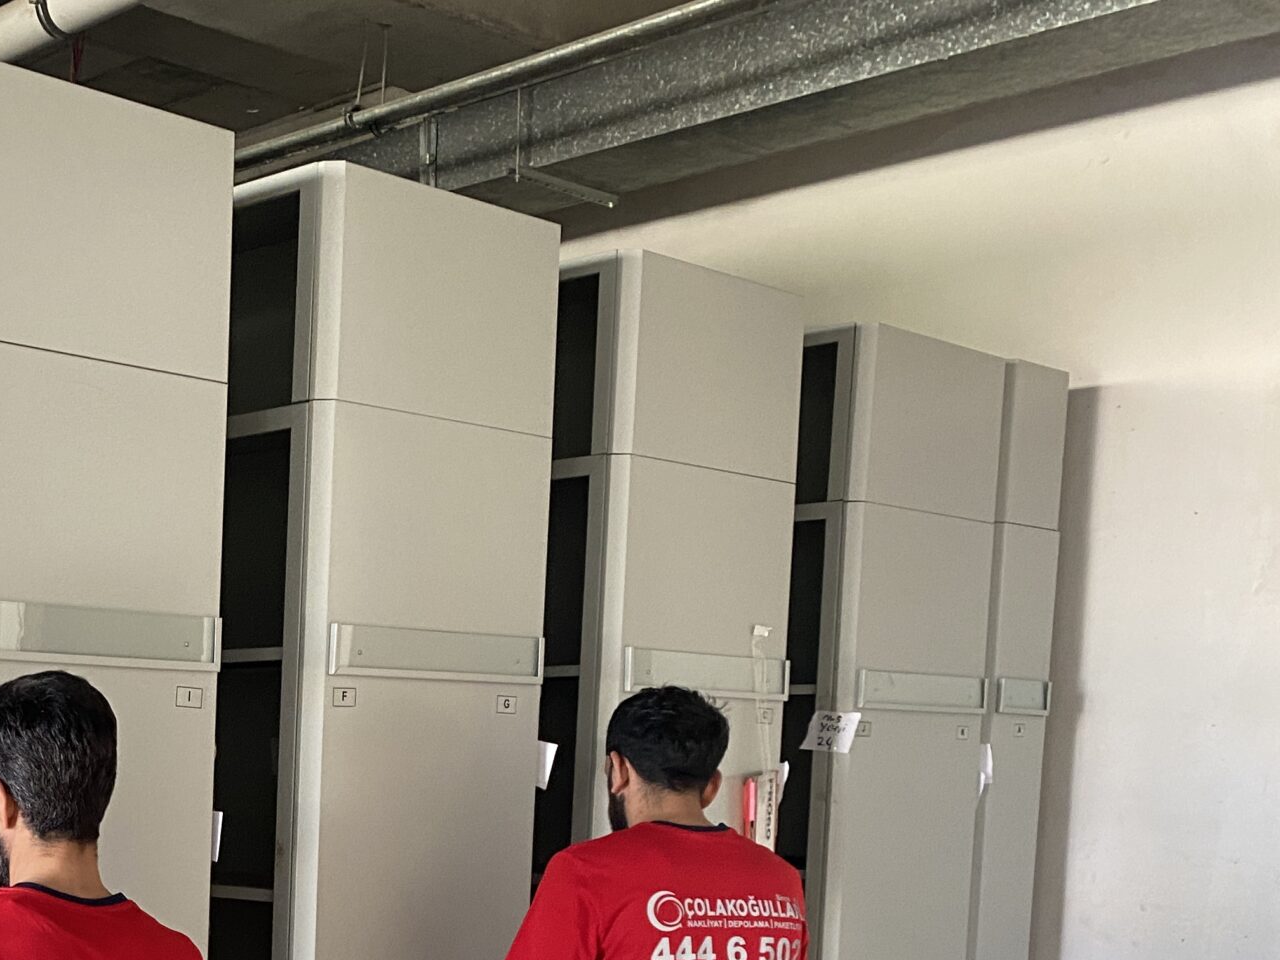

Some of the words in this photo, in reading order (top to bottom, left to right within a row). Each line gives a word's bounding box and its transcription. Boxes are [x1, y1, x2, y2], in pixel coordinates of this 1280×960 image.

[341, 690, 348, 702] F
[503, 698, 510, 709] G
[728, 920, 769, 929] DEPOLAMA
